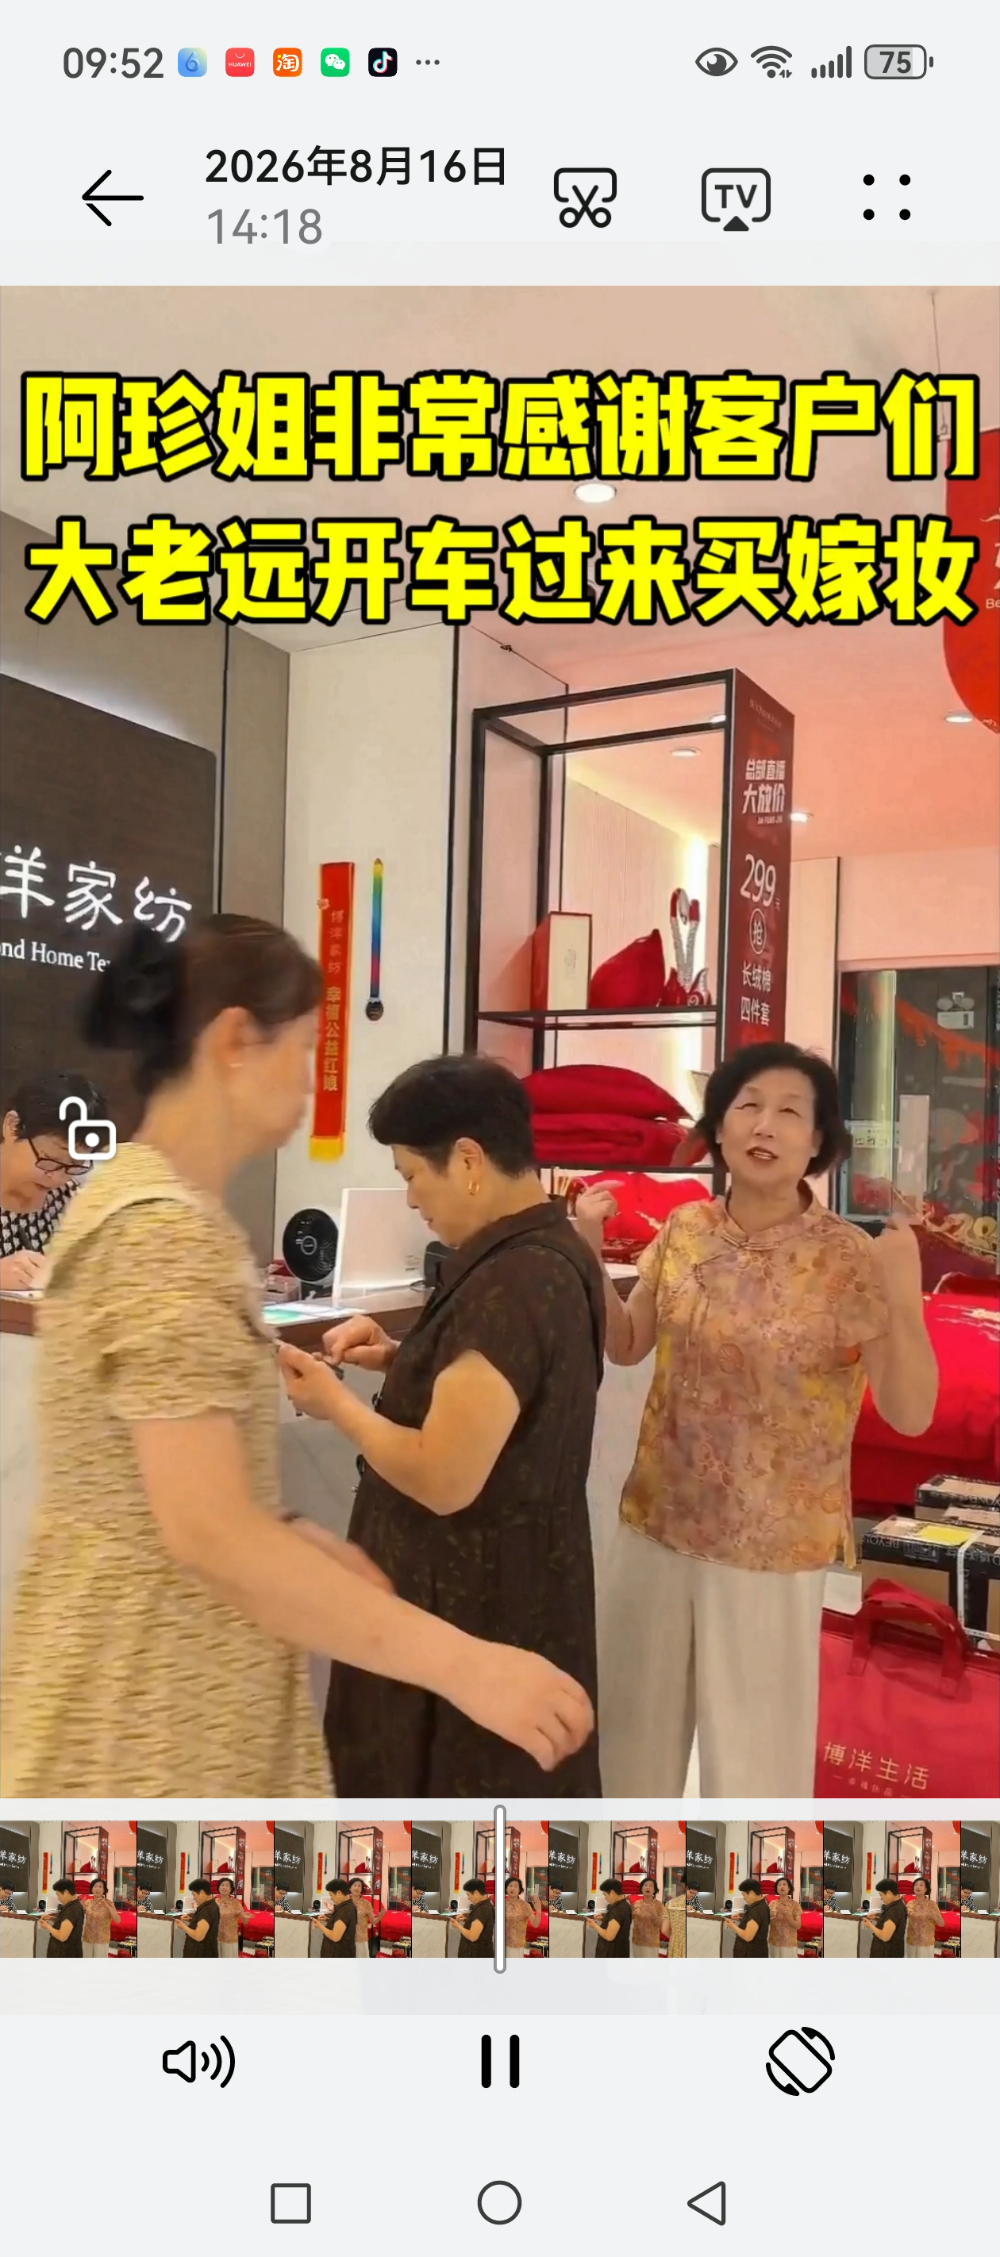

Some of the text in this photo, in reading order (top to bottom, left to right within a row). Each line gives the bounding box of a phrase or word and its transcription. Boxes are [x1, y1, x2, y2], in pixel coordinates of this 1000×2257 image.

[745, 759, 786, 781] 总部直播
[742, 783, 786, 814] 大放价
[740, 853, 777, 907] 299
[752, 921, 764, 946] 抢
[0, 938, 111, 973] nd Home Te
[741, 960, 772, 993] 长绒棉
[740, 996, 771, 1026] 四件套
[823, 1741, 930, 1790] 博洋生活
